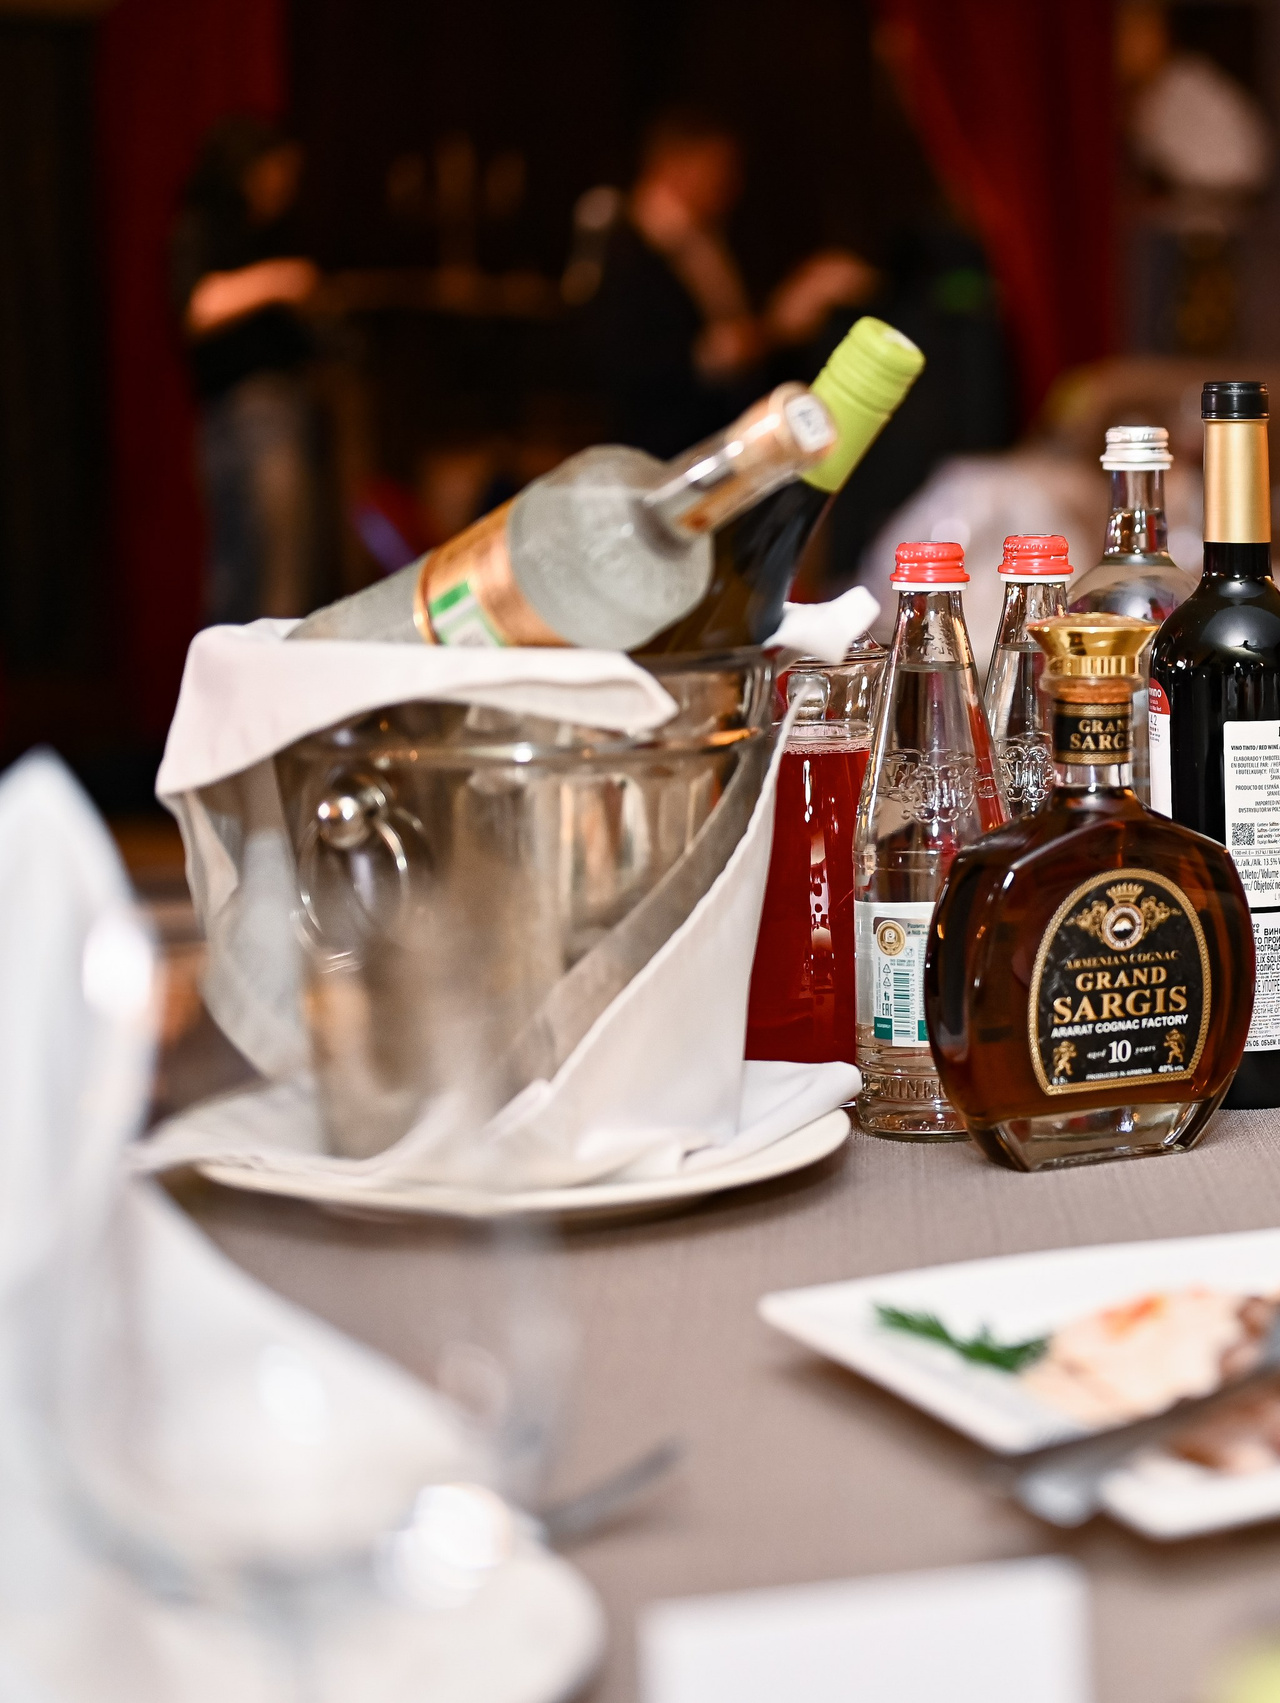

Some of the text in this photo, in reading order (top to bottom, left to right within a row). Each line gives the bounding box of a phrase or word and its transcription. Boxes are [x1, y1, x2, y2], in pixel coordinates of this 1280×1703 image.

[1079, 719, 1125, 733] GRAN
[1070, 733, 1125, 751] SARG
[1261, 869, 1279, 879] Volume
[1065, 950, 1179, 970] ARMENIAN COGNAC
[1075, 966, 1167, 992] GRAND
[1053, 985, 1188, 1025] SARGIS
[1051, 1014, 1189, 1039] ARARAT COGNAC FACTORY
[1087, 1040, 1157, 1064] aged 10 years
[1159, 1064, 1174, 1073] 40%
